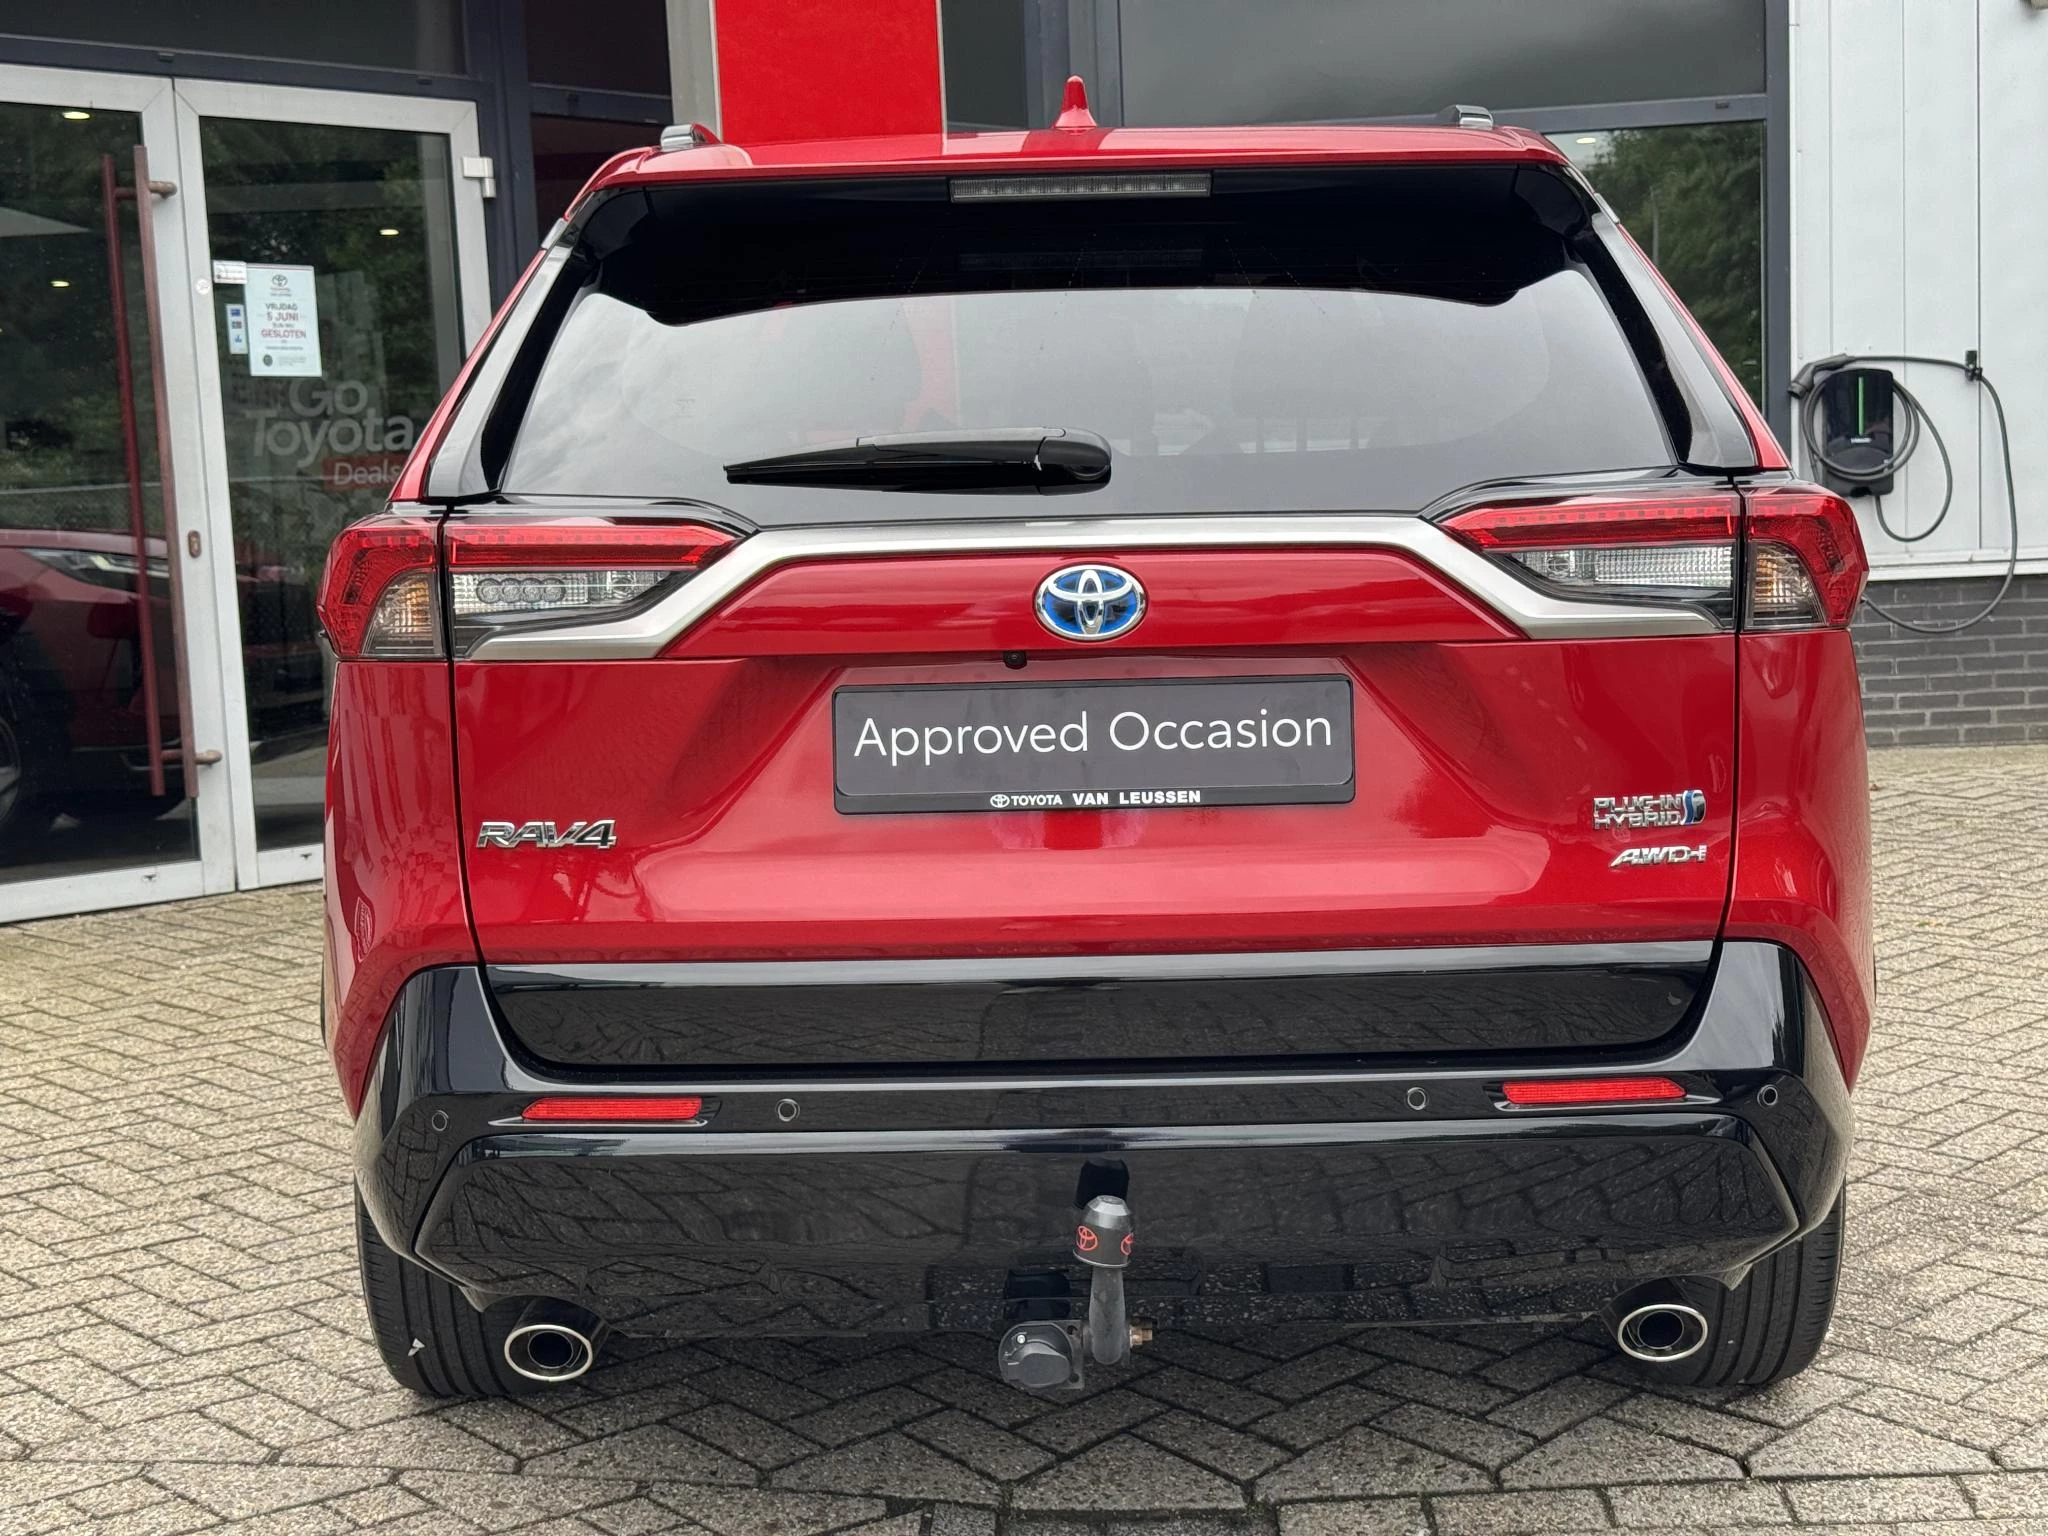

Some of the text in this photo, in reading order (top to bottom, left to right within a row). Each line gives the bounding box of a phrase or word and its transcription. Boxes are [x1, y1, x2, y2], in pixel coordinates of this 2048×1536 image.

[275, 312, 299, 321] JUNI
[261, 329, 306, 338] GESLOTEN
[289, 380, 369, 417] Go
[246, 409, 414, 468] Toyota
[334, 459, 400, 485] Deals
[854, 709, 1332, 766] Approved Occasion
[1010, 790, 1201, 806] TOYOTA VAN LEUSSEN
[1593, 794, 1683, 812] PLUG-IN
[1593, 811, 1681, 829] HYBRID
[475, 819, 617, 849] RAV4
